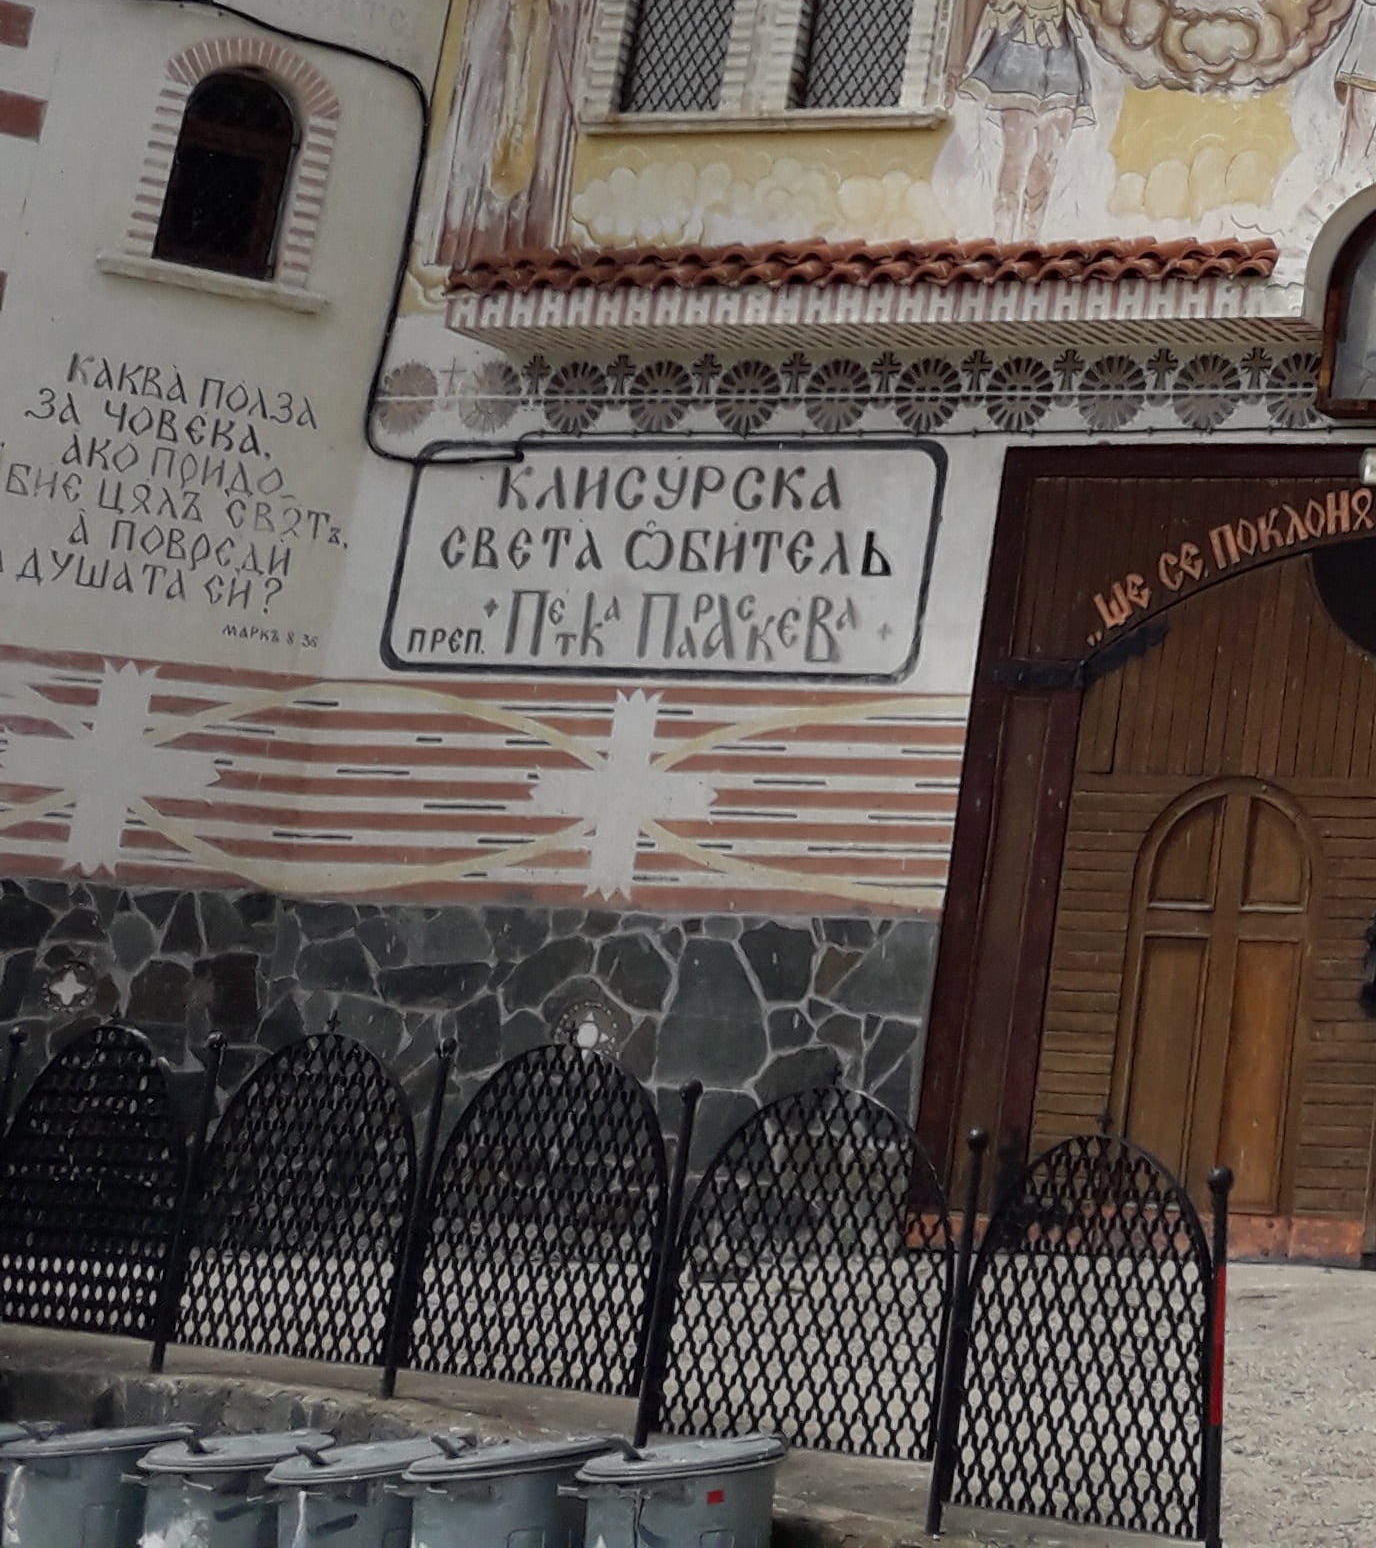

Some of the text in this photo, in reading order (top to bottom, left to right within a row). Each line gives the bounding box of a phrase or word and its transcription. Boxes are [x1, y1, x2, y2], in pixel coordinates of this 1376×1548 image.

[25, 387, 82, 426] ЗА
[67, 352, 318, 430] КАКВА ПОЛЗА
[61, 433, 140, 473] АКО
[498, 464, 843, 512] КЛИСУРСКА
[68, 507, 90, 546] А
[439, 520, 604, 572] СВЕТА
[1208, 487, 1376, 570] ПОКЛОНЯ
[16, 547, 187, 602] ДУШАТА
